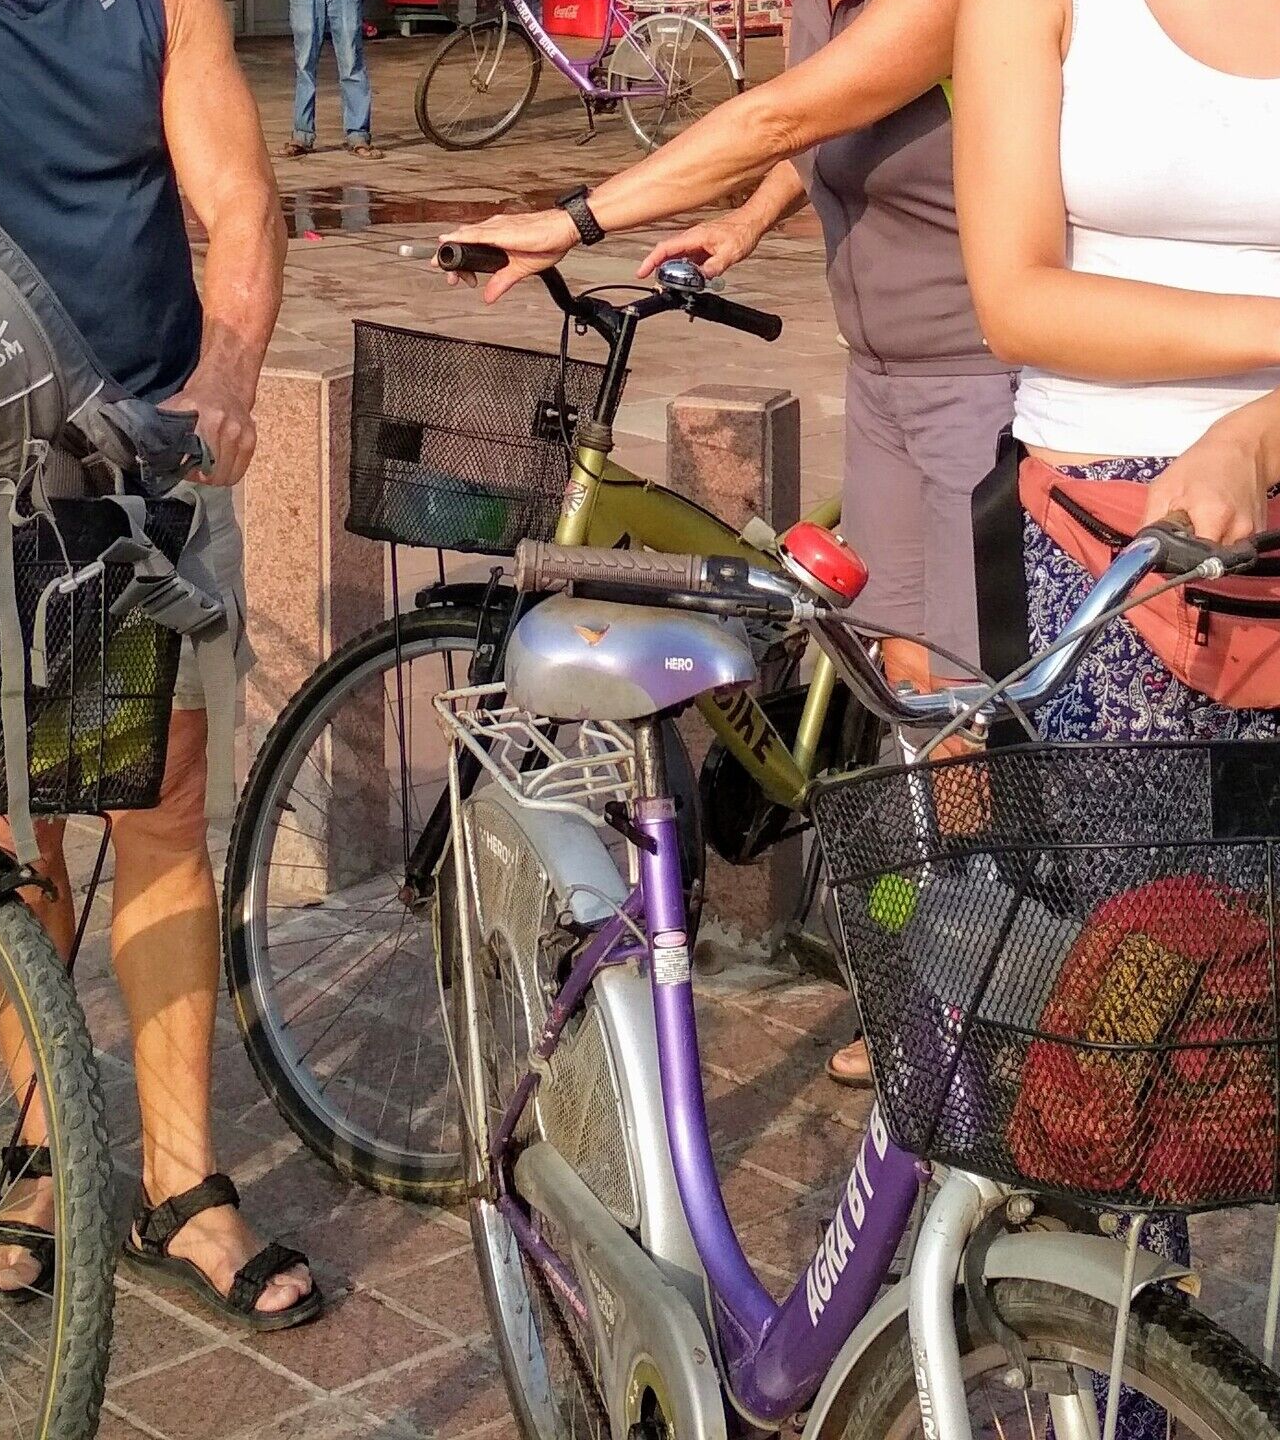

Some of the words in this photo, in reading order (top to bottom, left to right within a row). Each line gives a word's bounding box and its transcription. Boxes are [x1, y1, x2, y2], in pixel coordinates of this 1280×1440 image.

[528, 18, 542, 36] BY
[537, 30, 559, 59] BIKE
[664, 656, 693, 671] HERO
[486, 835, 509, 865] HERO
[806, 1202, 856, 1328] AGRA
[847, 1136, 874, 1231] BY
